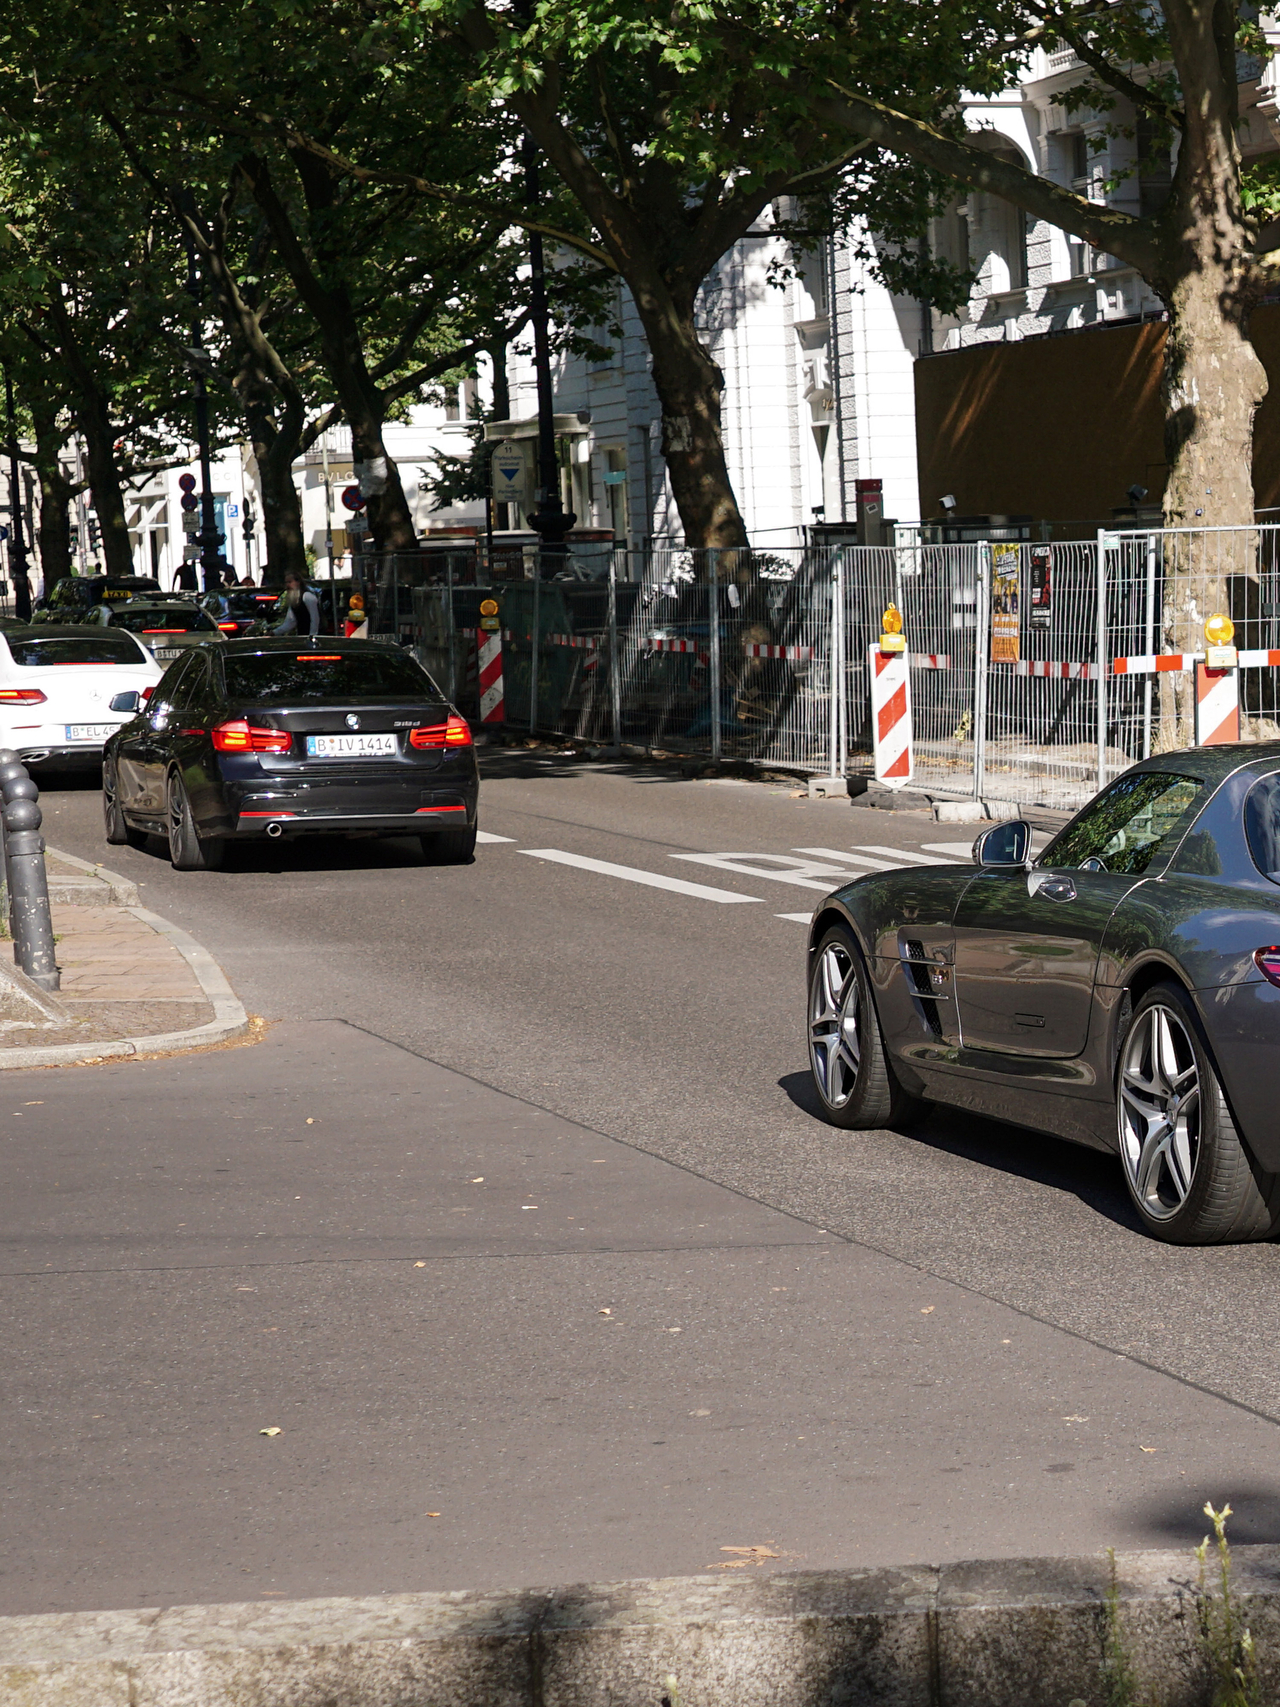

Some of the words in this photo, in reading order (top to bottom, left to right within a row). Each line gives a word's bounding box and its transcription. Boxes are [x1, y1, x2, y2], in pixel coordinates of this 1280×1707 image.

[73, 727, 79, 737] B
[86, 727, 100, 737] EL
[318, 739, 327, 751] B
[338, 738, 354, 751] IV
[358, 738, 392, 751] 1414
